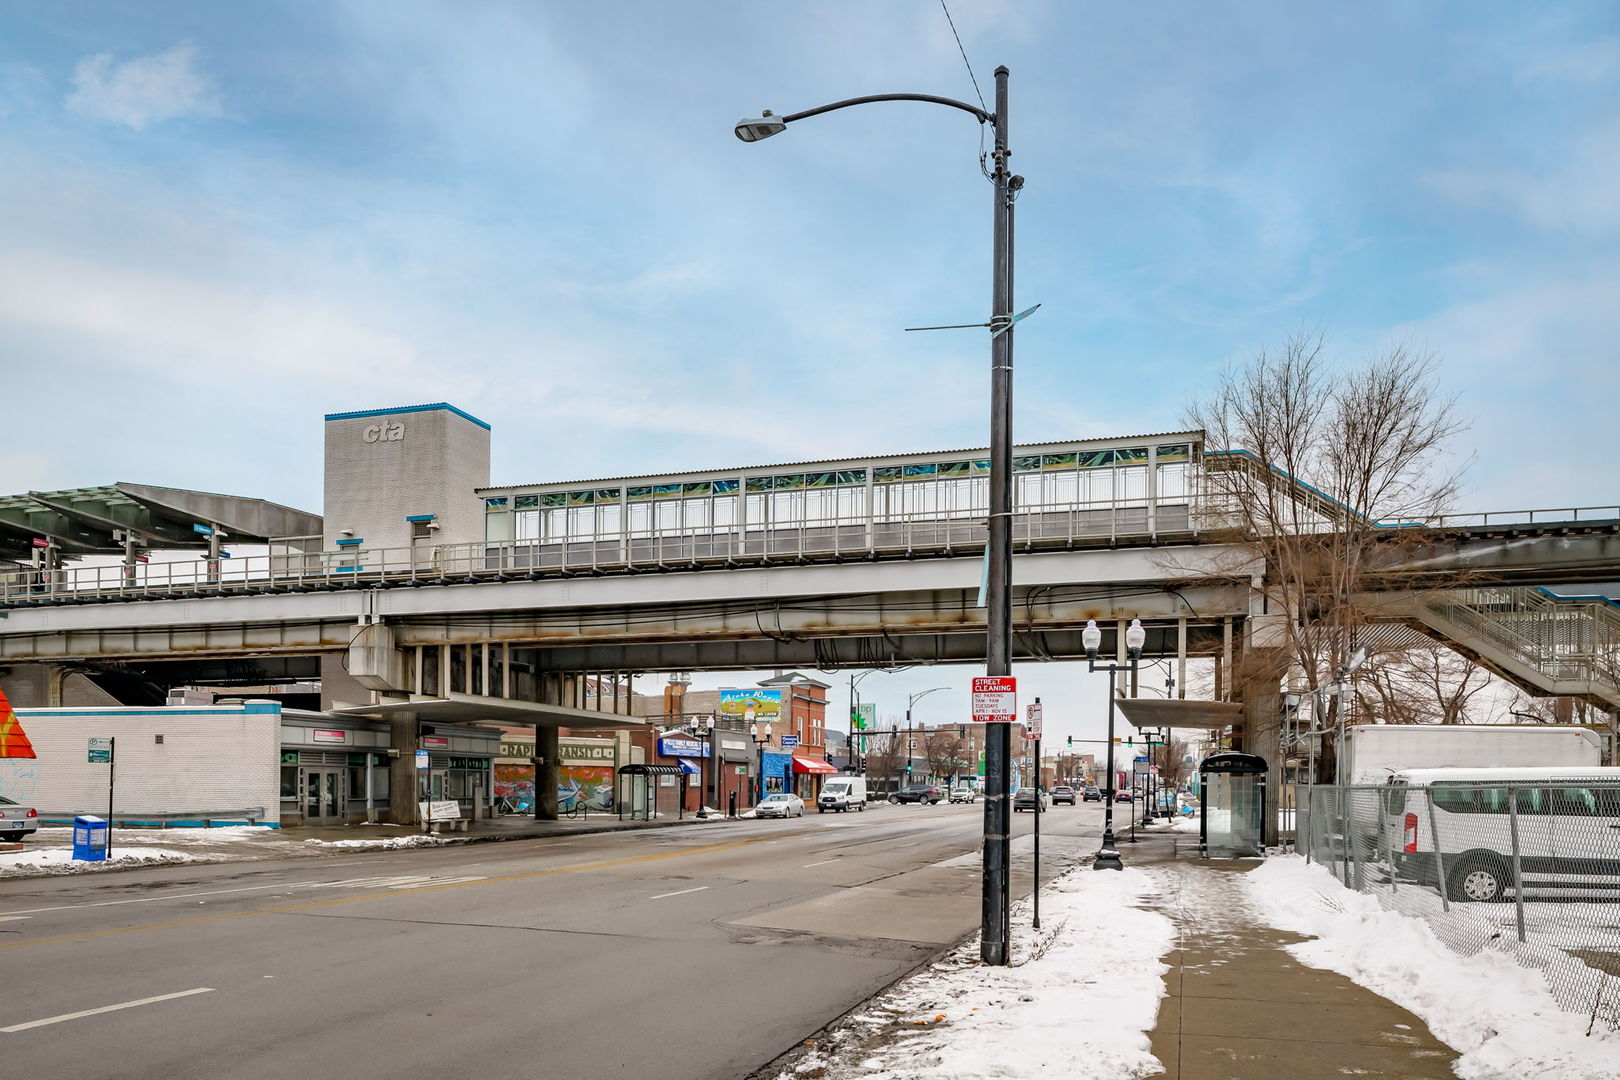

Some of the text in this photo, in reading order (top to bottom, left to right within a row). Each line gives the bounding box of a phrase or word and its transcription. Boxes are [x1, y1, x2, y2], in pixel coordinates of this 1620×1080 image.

[363, 420, 406, 443] cta
[507, 744, 535, 757] RAPI
[558, 745, 594, 758] RANSIT
